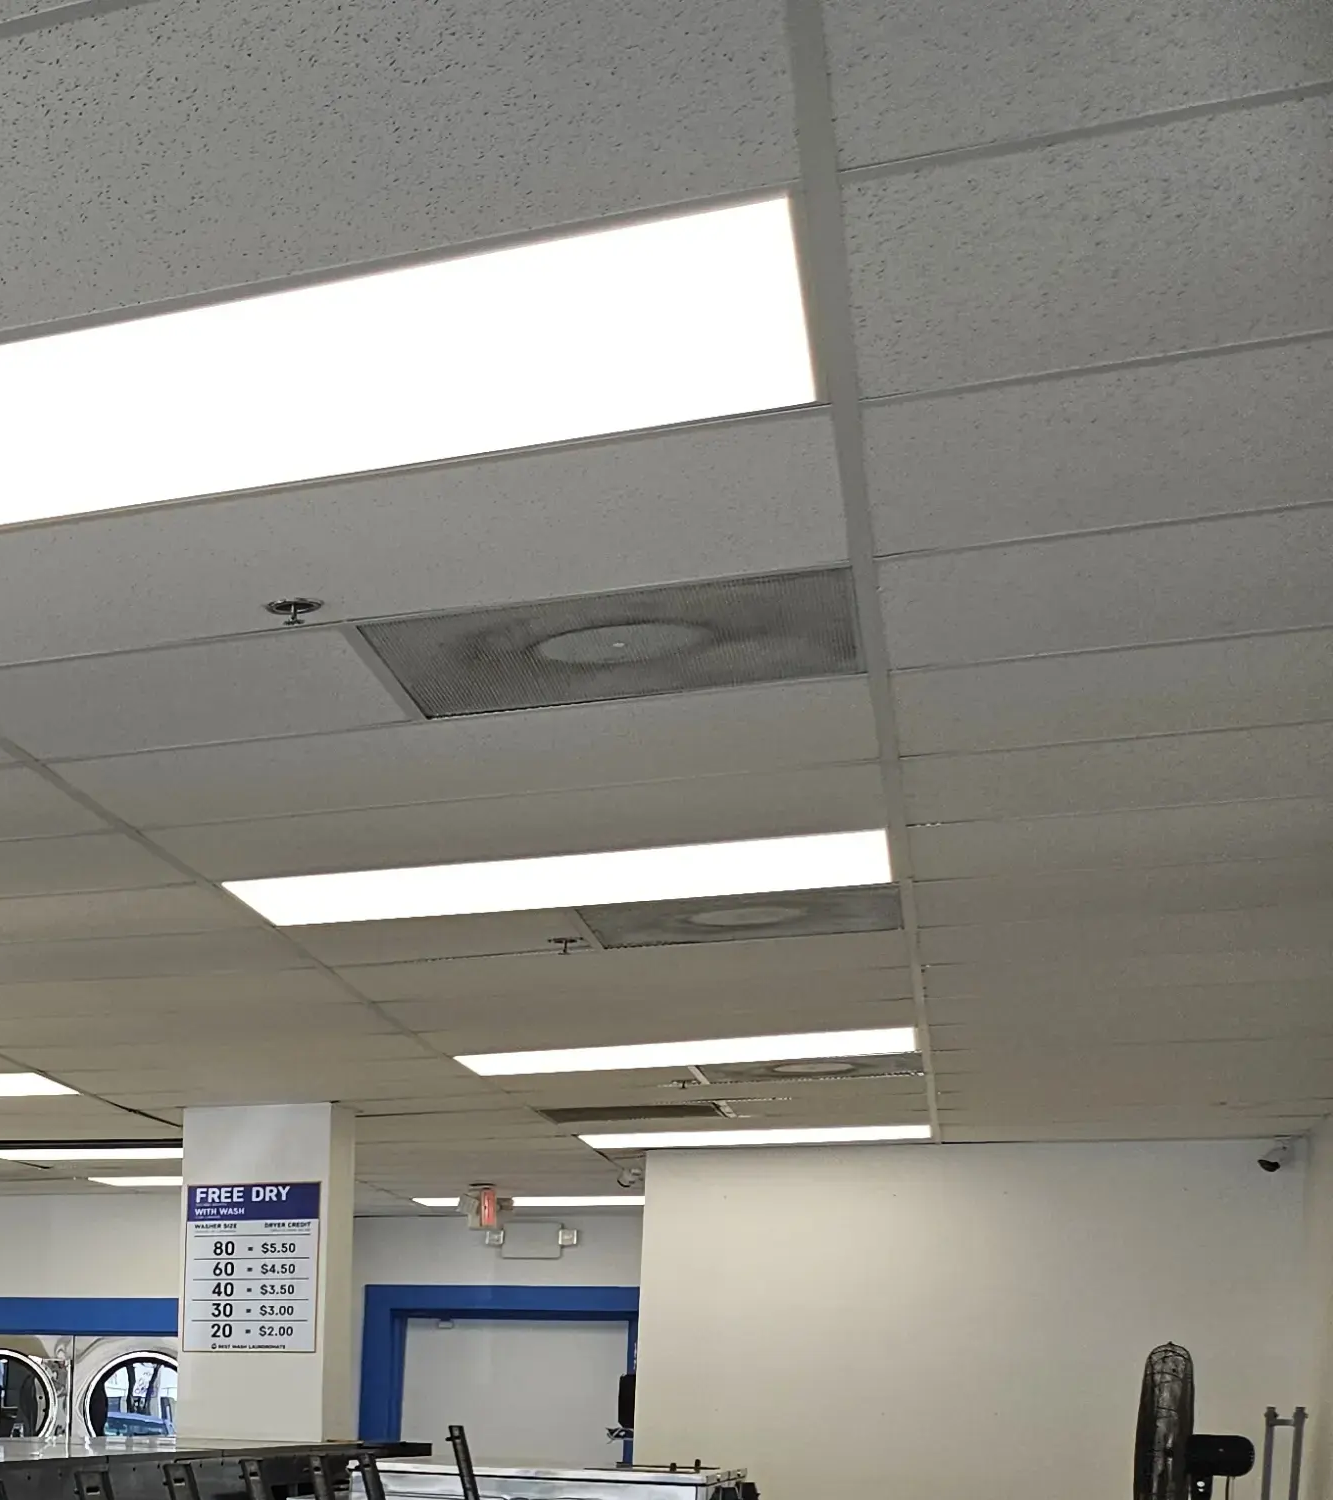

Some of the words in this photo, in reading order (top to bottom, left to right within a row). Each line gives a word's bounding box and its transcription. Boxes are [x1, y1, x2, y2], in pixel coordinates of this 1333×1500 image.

[196, 1187, 244, 1203] FREE
[252, 1186, 291, 1201] DRY
[195, 1208, 217, 1216] WITH
[220, 1207, 245, 1215] WASH
[213, 1241, 235, 1256] 80
[261, 1242, 296, 1254] $5.50
[213, 1261, 235, 1276] 60
[260, 1263, 296, 1275] $4.50
[212, 1282, 234, 1297] 40
[260, 1284, 295, 1295] $3.50
[211, 1303, 233, 1318] 30
[259, 1305, 294, 1316] $3.00
[211, 1323, 233, 1338] 20
[259, 1326, 294, 1337] $2.00
